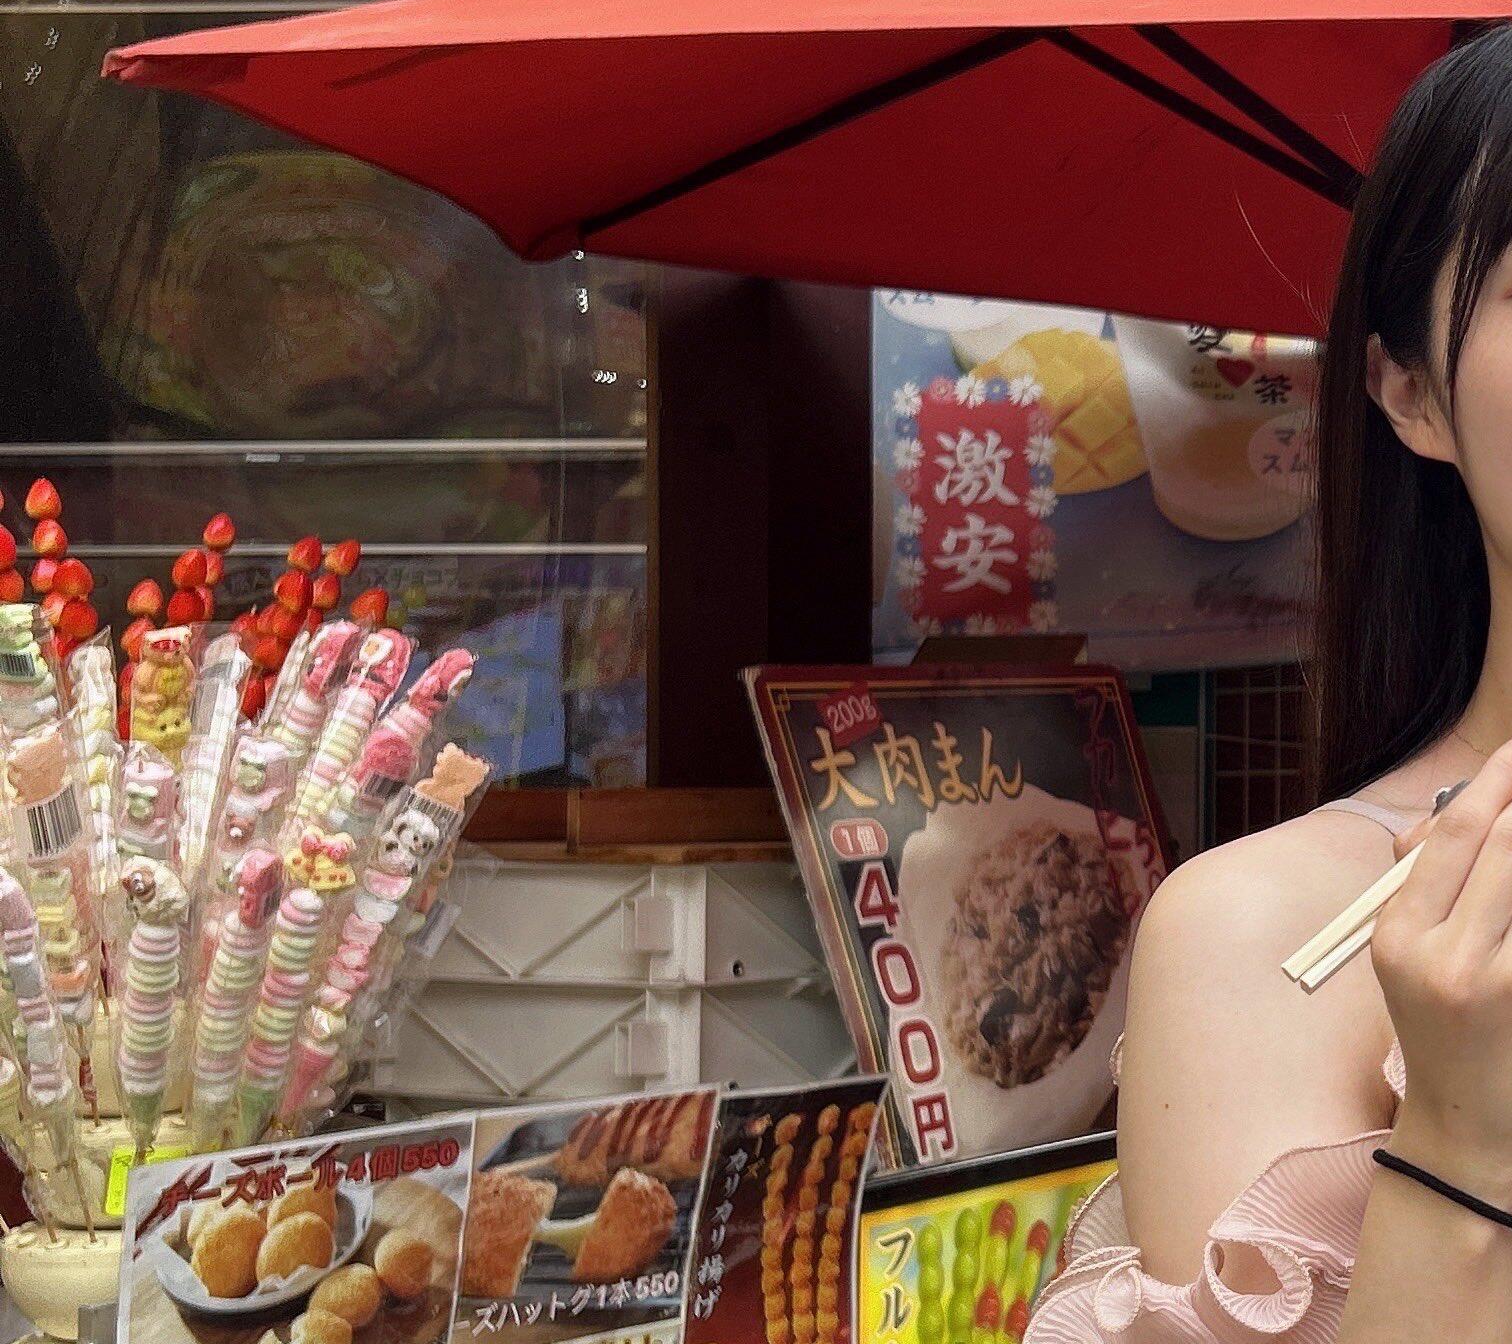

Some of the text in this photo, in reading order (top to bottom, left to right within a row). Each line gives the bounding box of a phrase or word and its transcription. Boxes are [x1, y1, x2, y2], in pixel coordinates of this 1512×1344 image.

[933, 428, 1020, 594] 激安
[811, 721, 1024, 811] 大肉まん
[855, 864, 956, 1162] 400円
